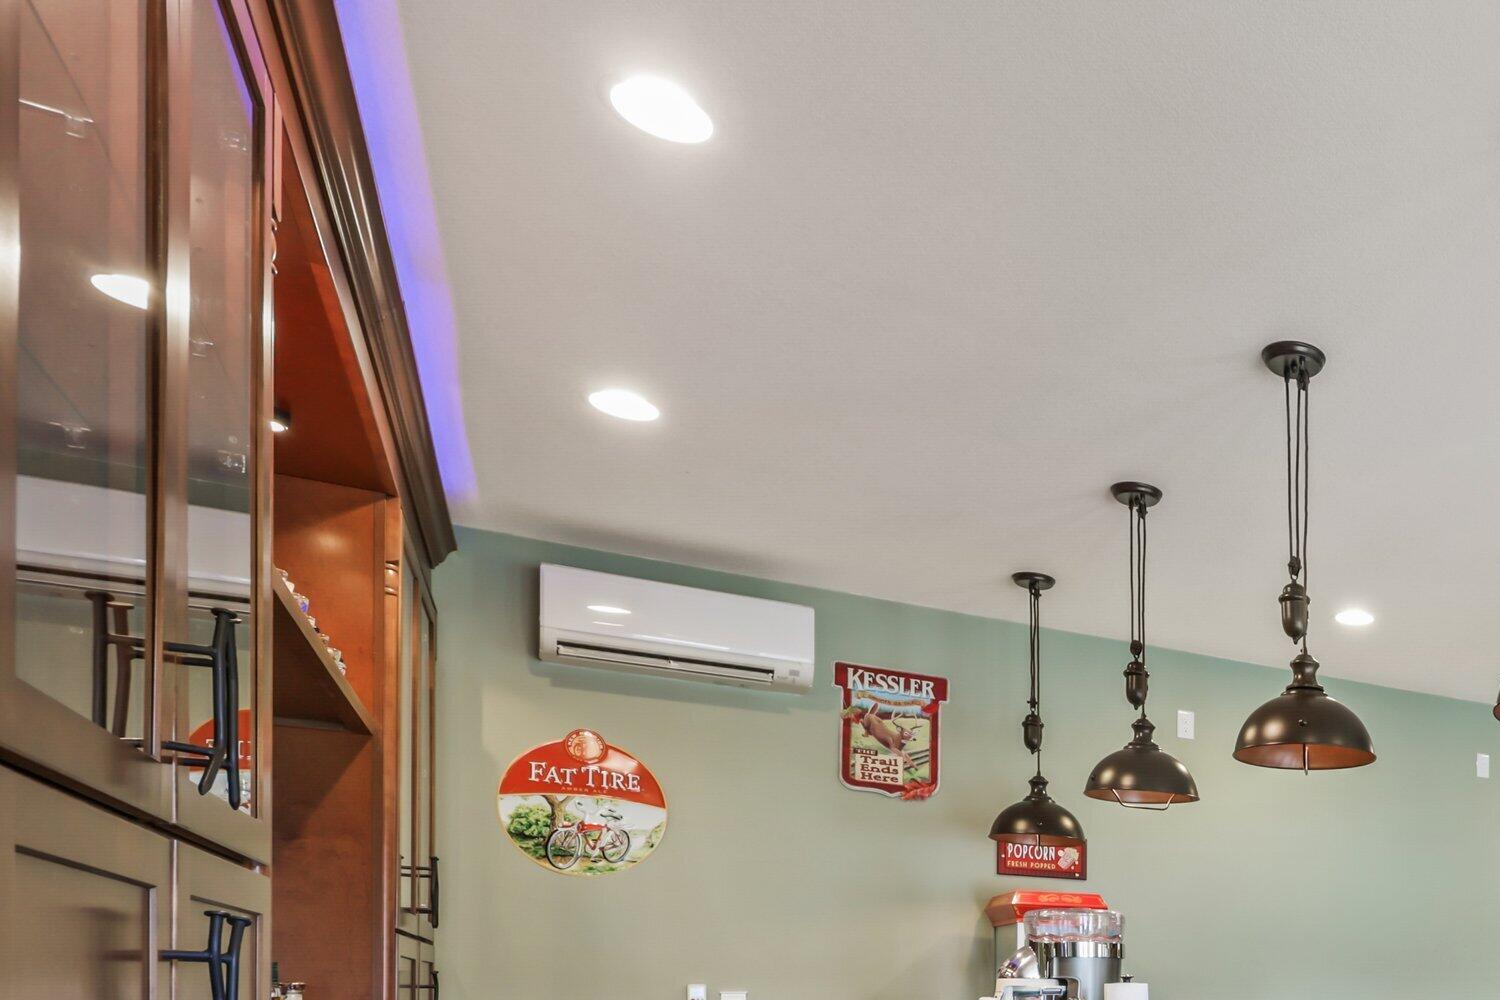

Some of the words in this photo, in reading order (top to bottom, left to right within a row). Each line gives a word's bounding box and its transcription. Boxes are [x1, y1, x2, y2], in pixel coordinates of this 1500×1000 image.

[847, 667, 935, 699] KESSLER
[860, 755, 898, 767] Trail
[860, 764, 899, 775] Ends
[528, 761, 577, 786] FAT
[581, 765, 641, 793] TIRE
[860, 771, 899, 783] Here
[1006, 843, 1056, 860] POPCORN
[1007, 860, 1028, 868] FRESH
[1030, 862, 1056, 870] POPPED
